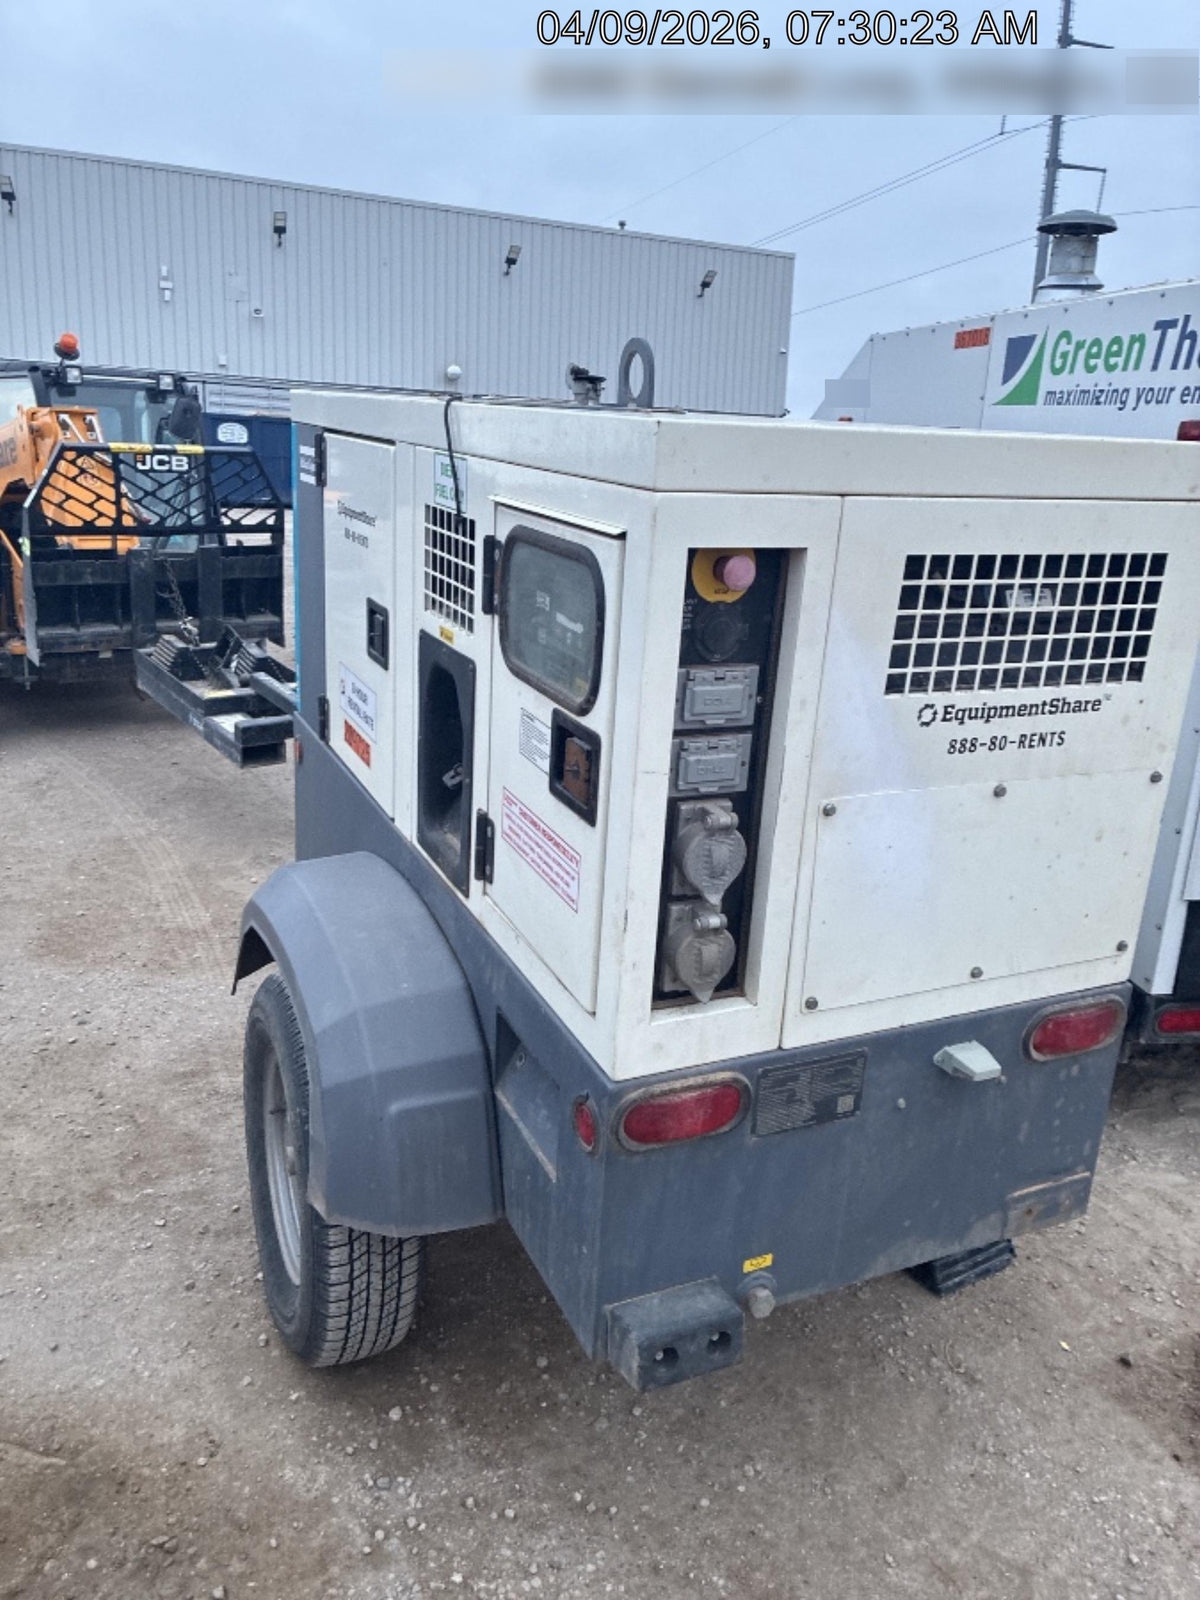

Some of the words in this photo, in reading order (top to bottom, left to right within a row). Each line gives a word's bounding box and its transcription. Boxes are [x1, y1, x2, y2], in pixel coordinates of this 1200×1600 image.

[1043, 382, 1130, 411] maximizing
[1131, 386, 1176, 411] your
[136, 455, 189, 471] JCB
[940, 697, 1102, 726] EquipmentShare
[947, 731, 1066, 755] 888-80-RENTS
